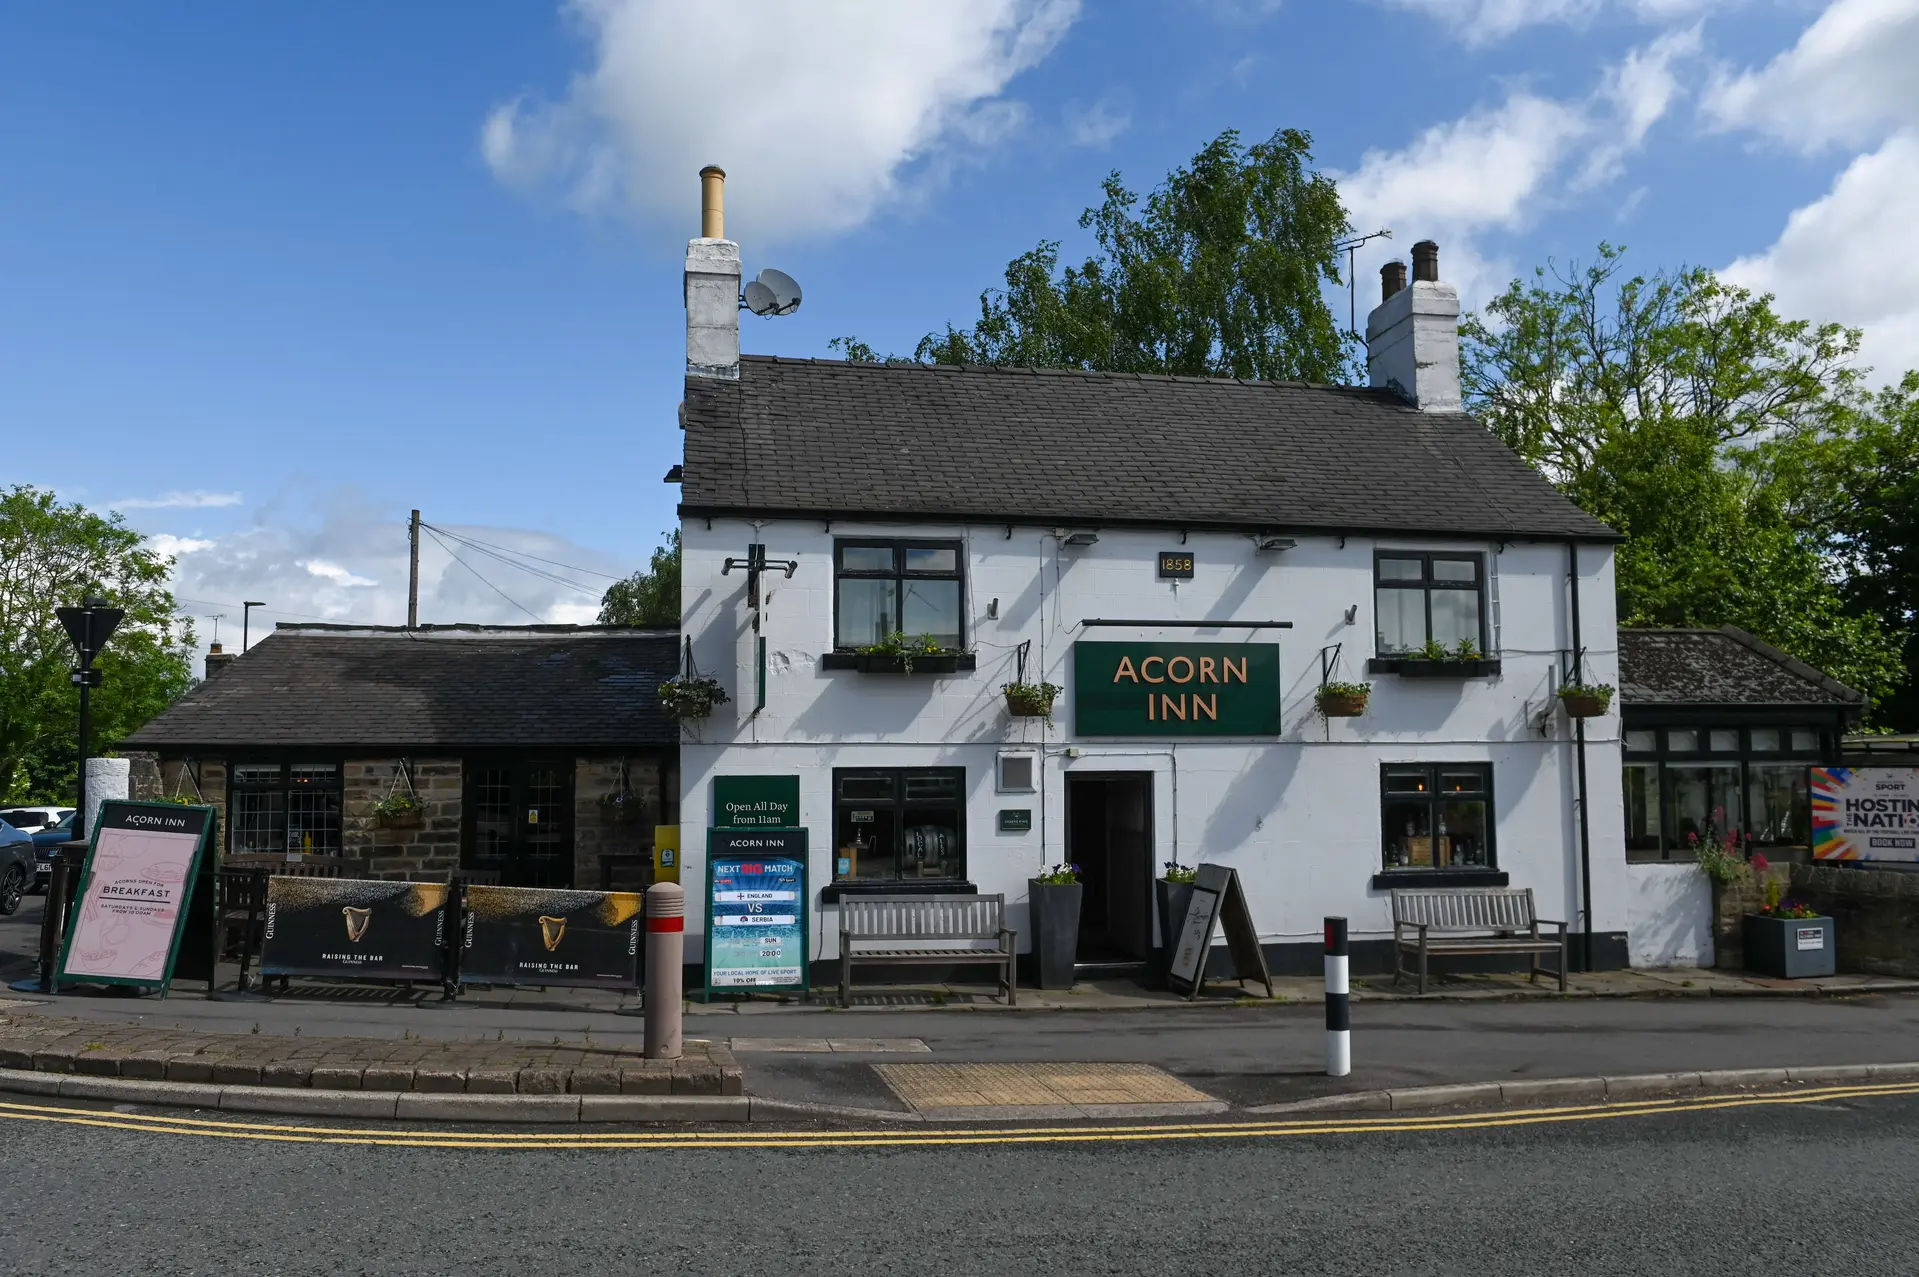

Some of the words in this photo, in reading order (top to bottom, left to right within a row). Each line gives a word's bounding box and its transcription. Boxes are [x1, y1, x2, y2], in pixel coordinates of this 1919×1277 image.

[1162, 559, 1192, 571] 1858
[1113, 656, 1247, 684] ACORN
[1148, 694, 1217, 721] INN
[726, 802, 751, 813] Open
[754, 802, 767, 811] All
[770, 802, 788, 812] Day
[125, 814, 162, 826] ACORN
[164, 818, 186, 827] INN
[733, 815, 756, 824] from
[759, 816, 781, 824] 11am
[1894, 839, 1914, 847] NOW
[717, 865, 740, 873] NEXT
[741, 864, 763, 874] BIG
[765, 865, 793, 873] MATCH
[103, 886, 170, 898] BREAKFAST
[748, 903, 763, 913] VS
[265, 903, 276, 940] GUINNESS
[434, 910, 445, 946] GUINNESS
[464, 912, 474, 948] GUINNESS
[628, 920, 638, 955] GUINNESS
